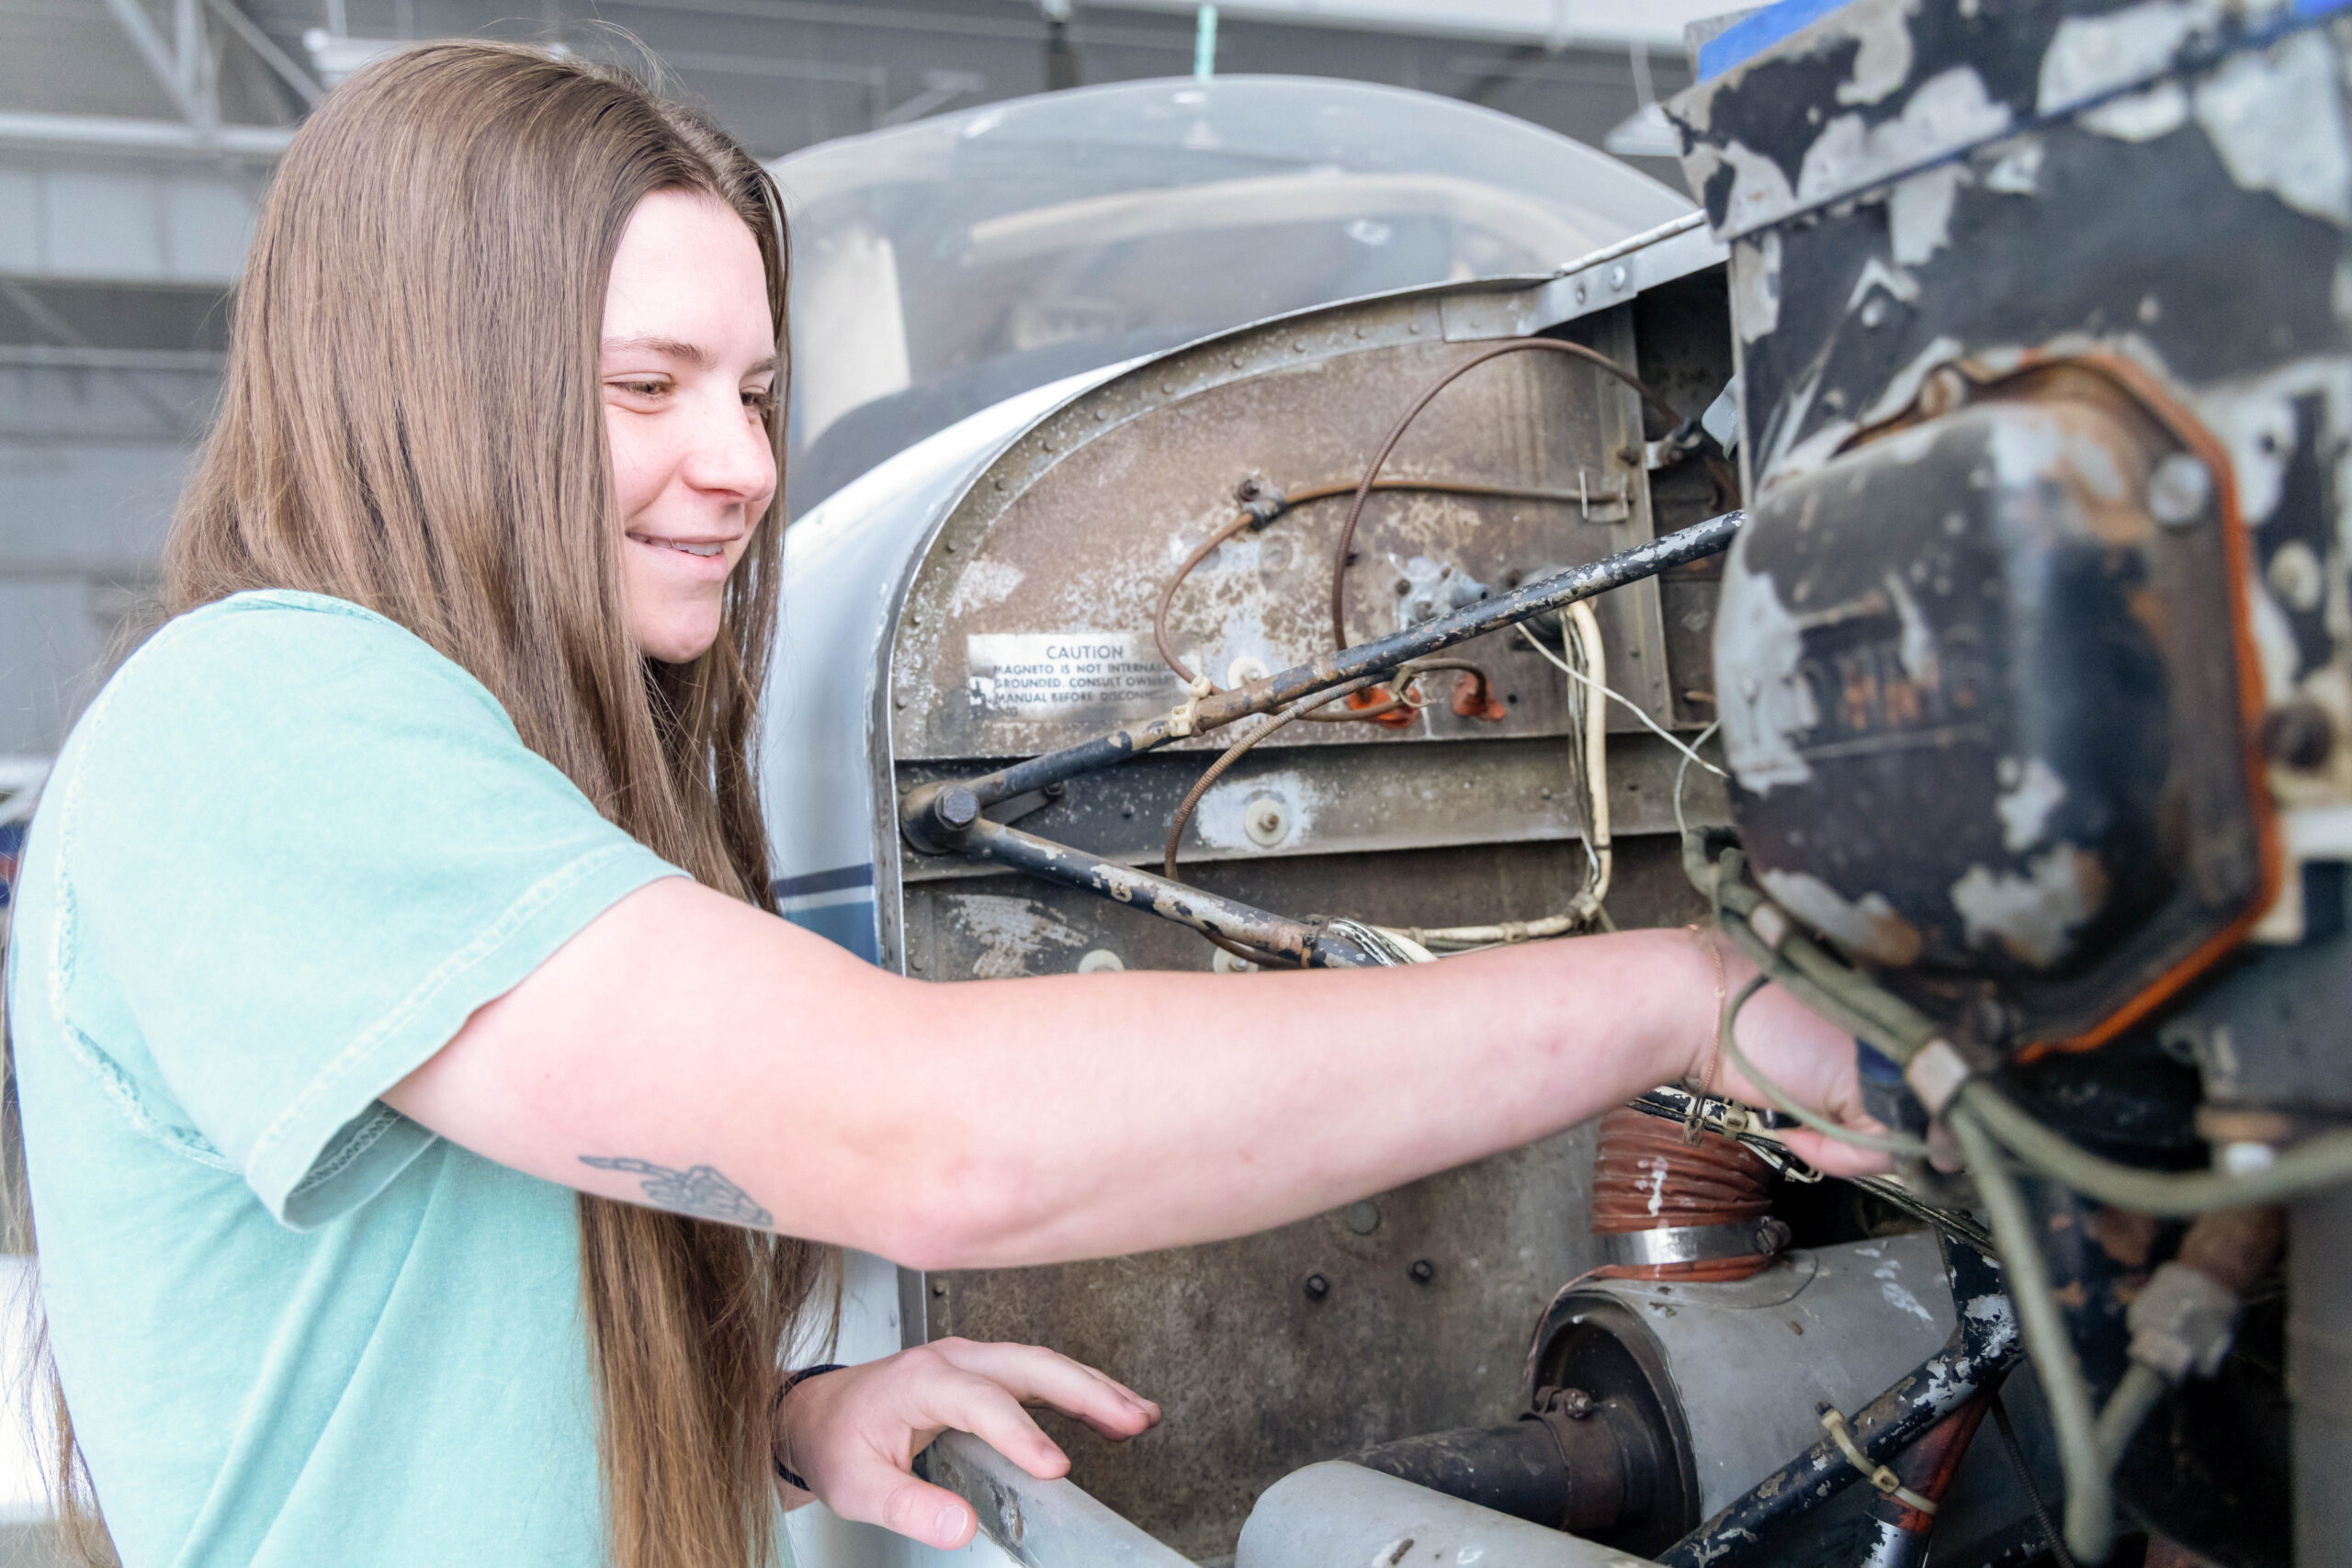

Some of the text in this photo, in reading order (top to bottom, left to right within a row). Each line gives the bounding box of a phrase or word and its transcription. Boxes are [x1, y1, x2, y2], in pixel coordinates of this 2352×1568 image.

[1046, 646, 1124, 660] CAUTION
[993, 662, 1173, 675] MAGNETO IS NOT INTERNALL
[1069, 677, 1121, 688] CONSULT
[995, 692, 1047, 703] MANUAL
[1051, 691, 1093, 703] BEFORE
